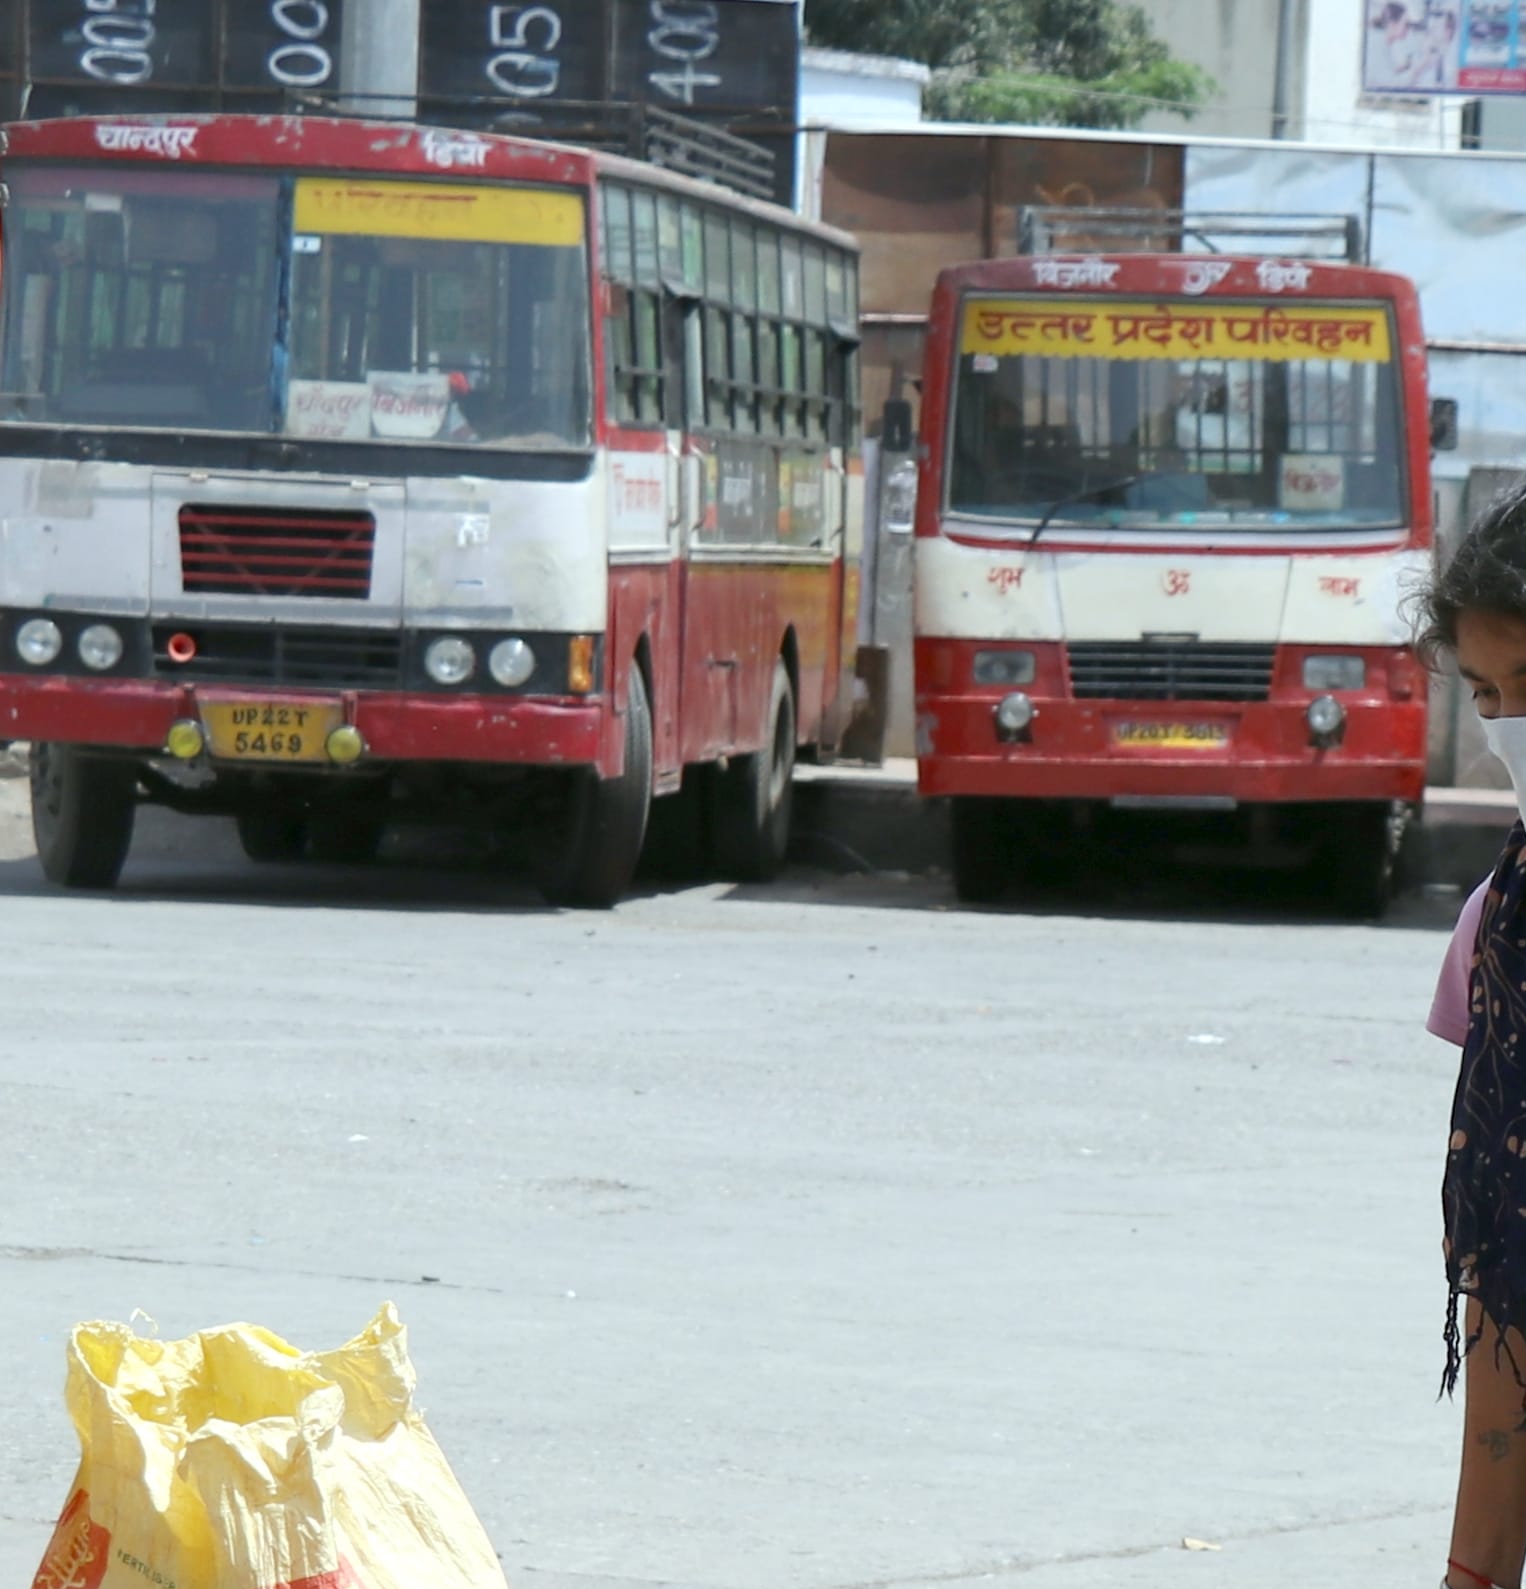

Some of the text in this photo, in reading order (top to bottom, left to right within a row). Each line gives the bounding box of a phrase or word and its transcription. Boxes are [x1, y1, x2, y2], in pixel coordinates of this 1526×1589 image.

[1105, 304, 1214, 348] प्रदेश
[1222, 306, 1375, 353] परिवहन
[235, 732, 302, 753] 5469
